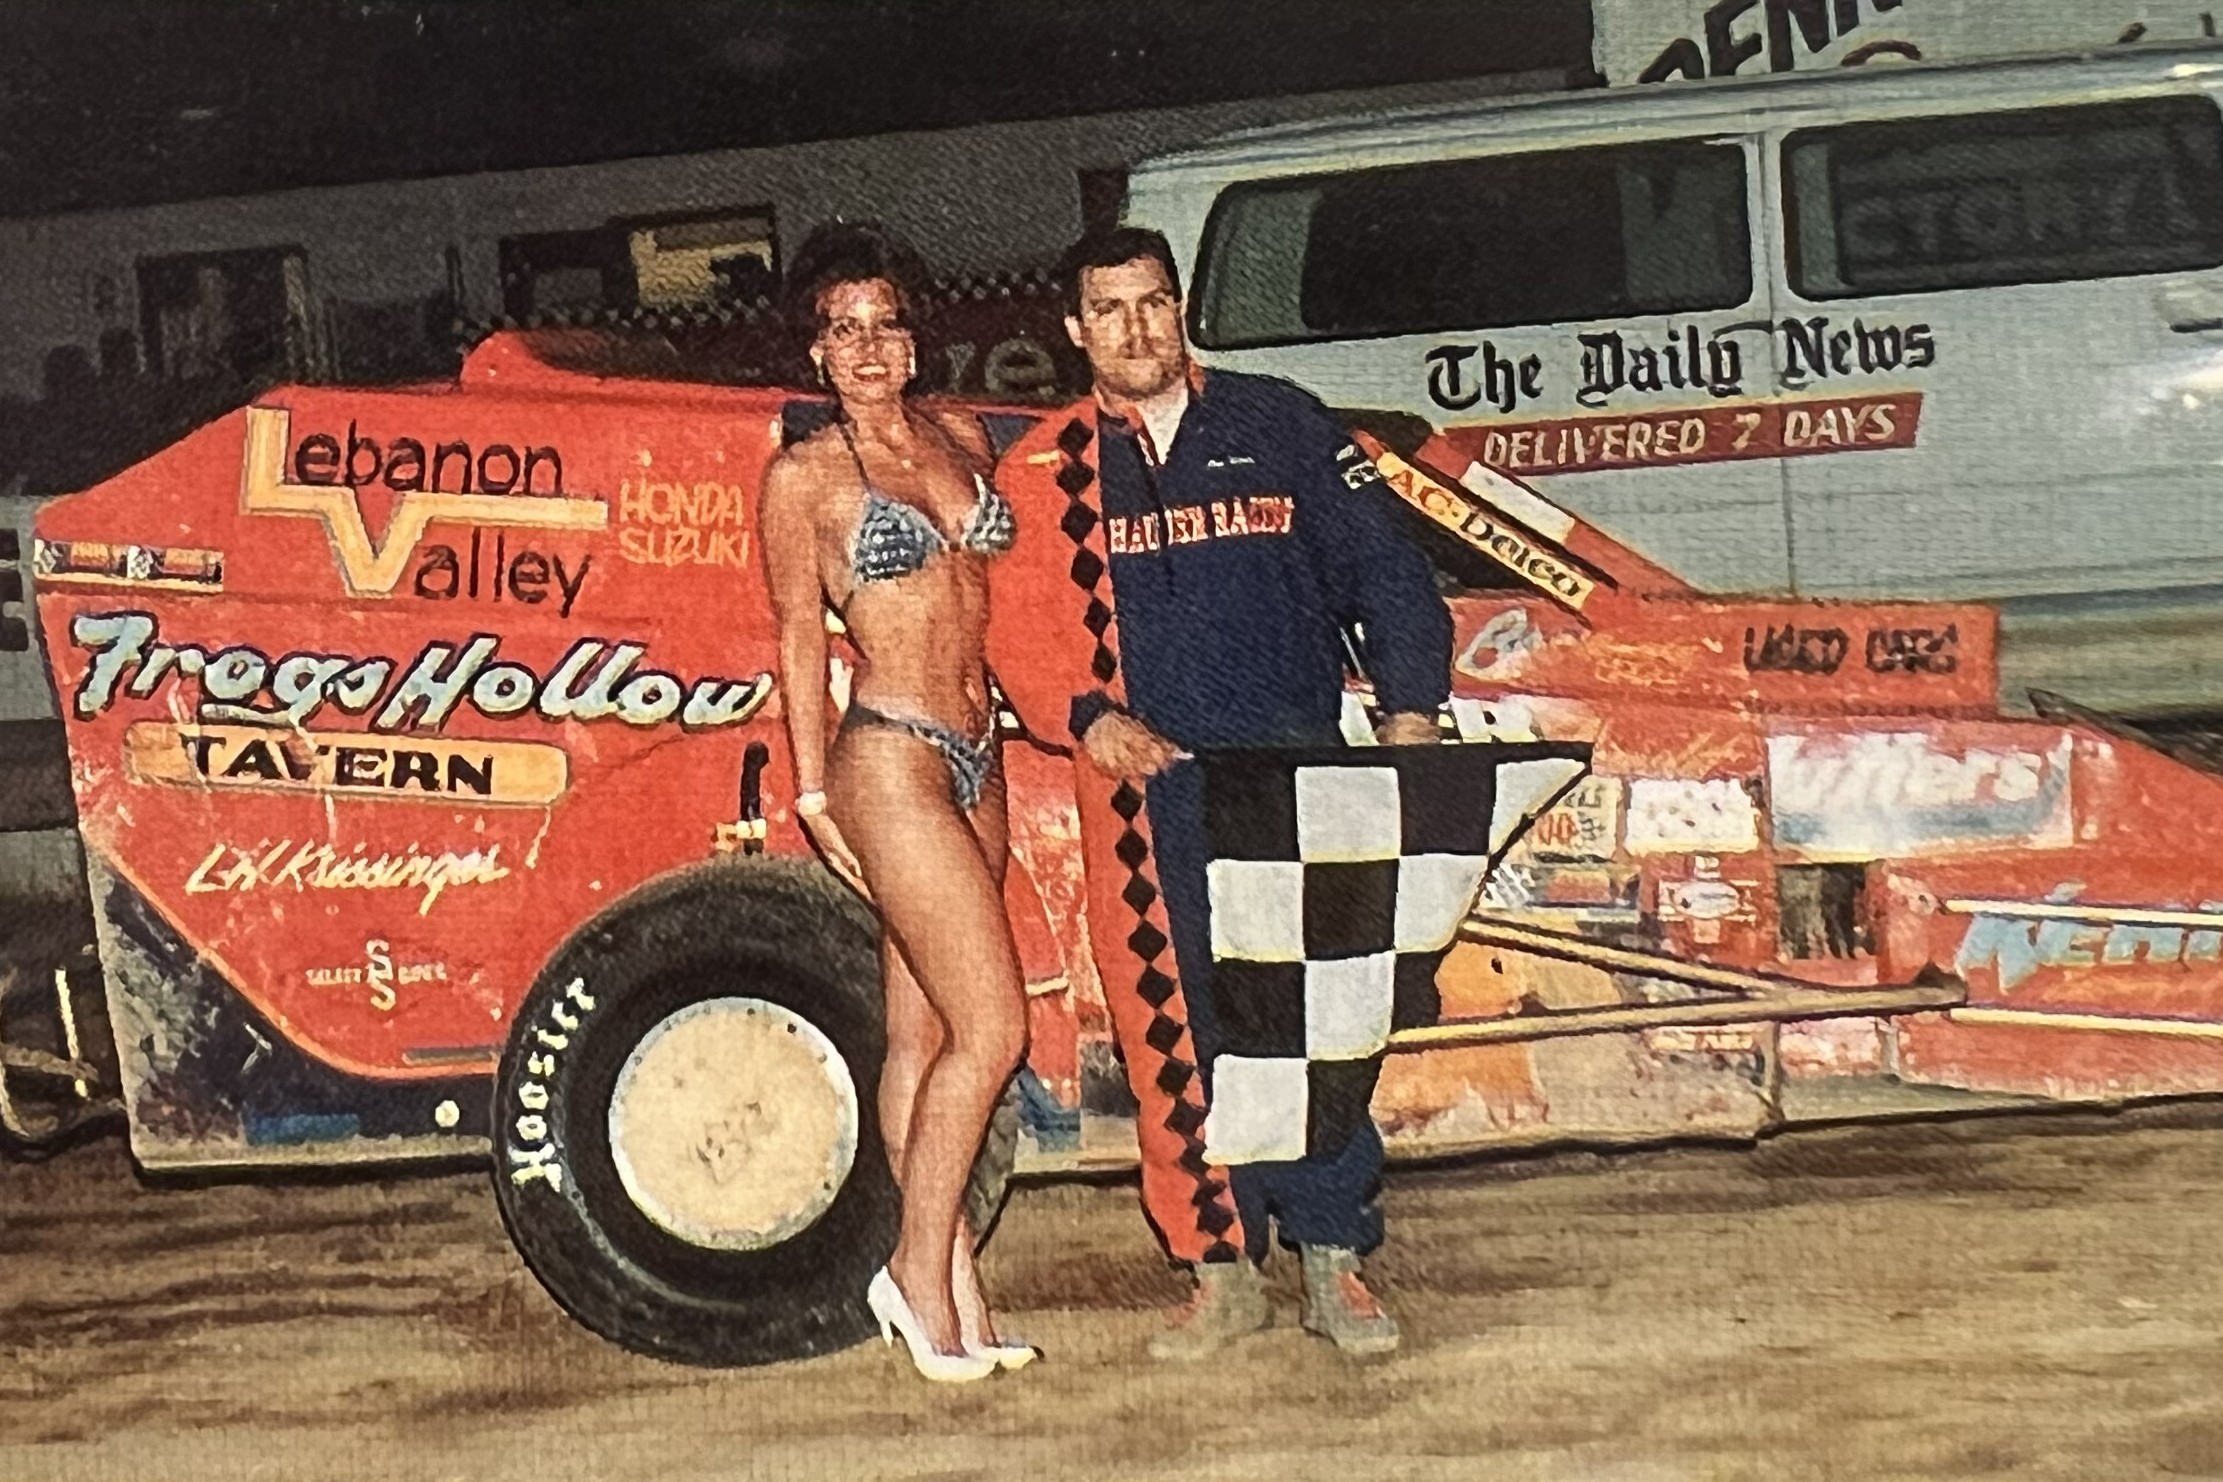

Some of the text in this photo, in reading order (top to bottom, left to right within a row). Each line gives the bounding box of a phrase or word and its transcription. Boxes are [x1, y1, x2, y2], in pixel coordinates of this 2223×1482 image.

[1426, 317, 1936, 412] The Daily News
[240, 405, 564, 515] Lebanon
[1484, 404, 1897, 468] DELIVERED 7 DAYS
[619, 476, 745, 526] HONDA
[619, 526, 751, 569] SUZUKI
[325, 495, 592, 619] Valley
[367, 632, 775, 733] Hollow
